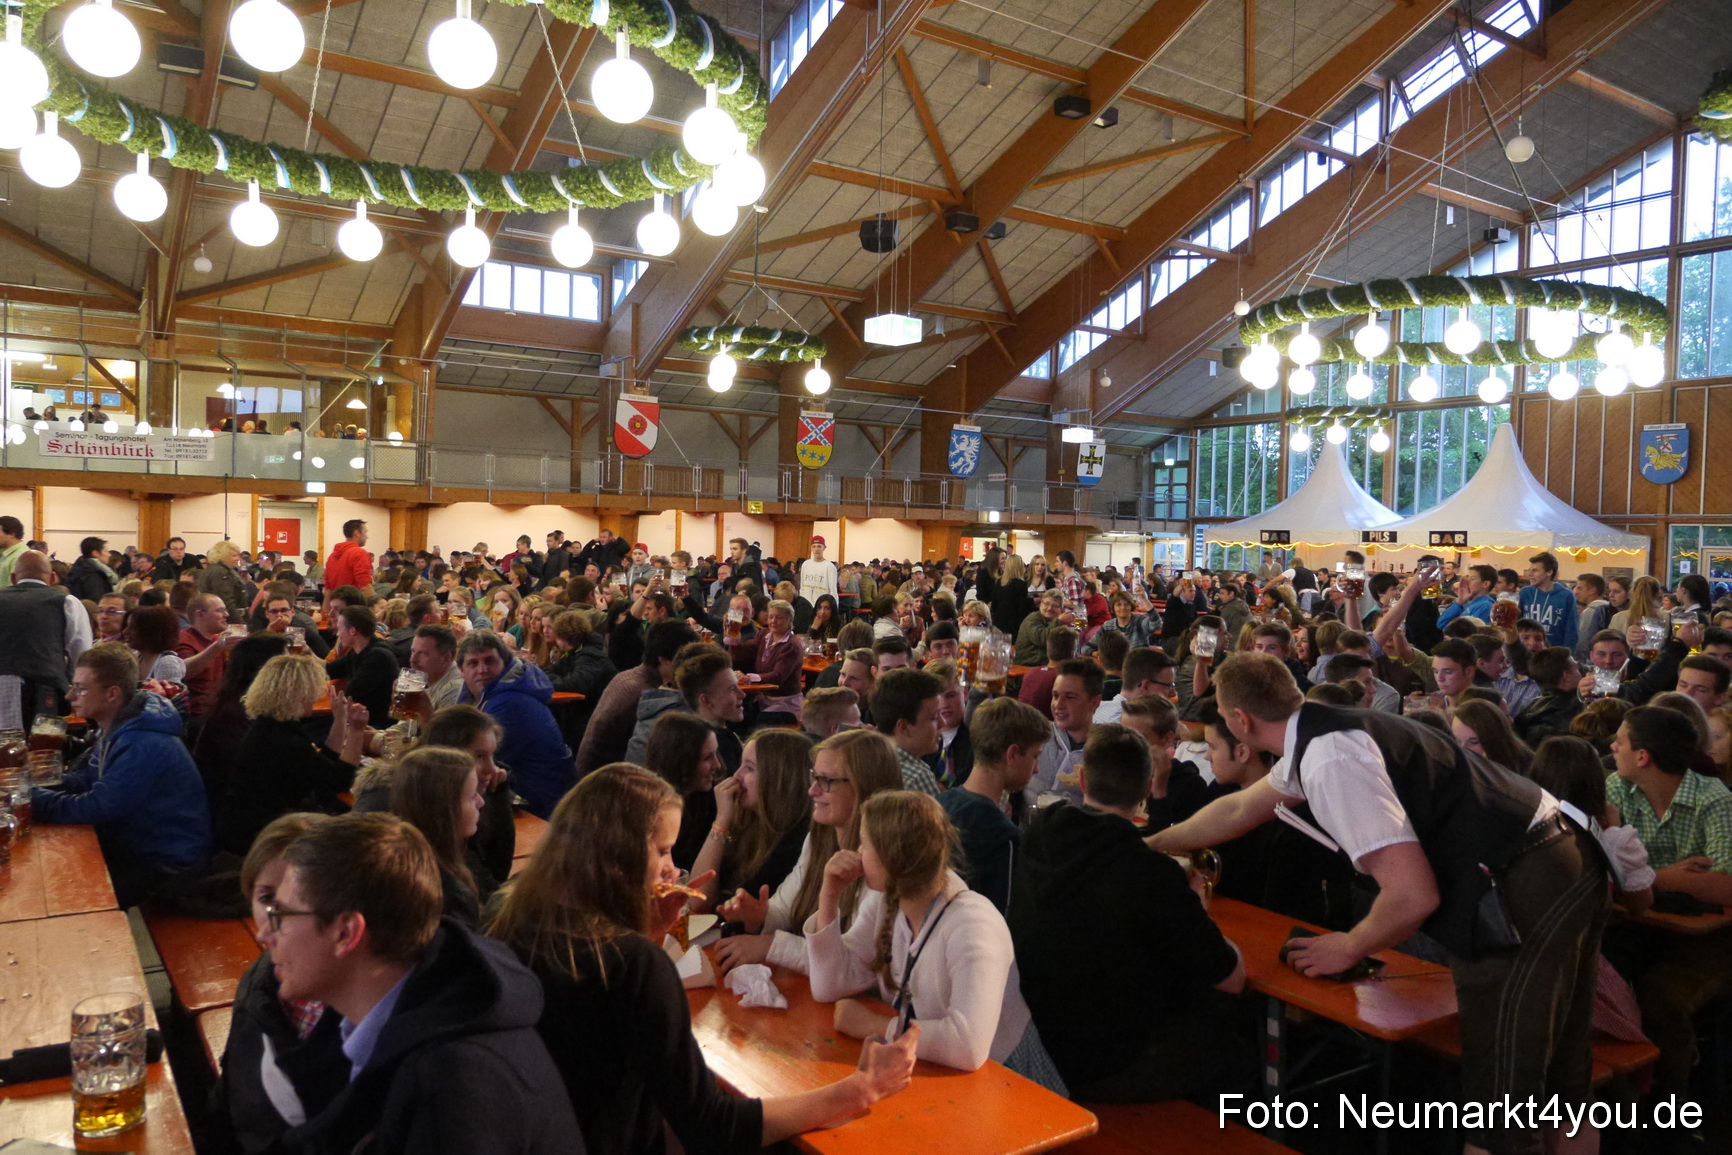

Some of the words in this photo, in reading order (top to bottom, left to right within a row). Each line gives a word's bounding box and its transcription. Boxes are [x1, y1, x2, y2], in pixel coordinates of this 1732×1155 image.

[95, 433, 146, 442] Tagungshotel
[47, 439, 155, 458] Schönblick
[1261, 532, 1289, 542] BAR
[1369, 531, 1390, 542] PILS
[1431, 533, 1465, 544] BAR
